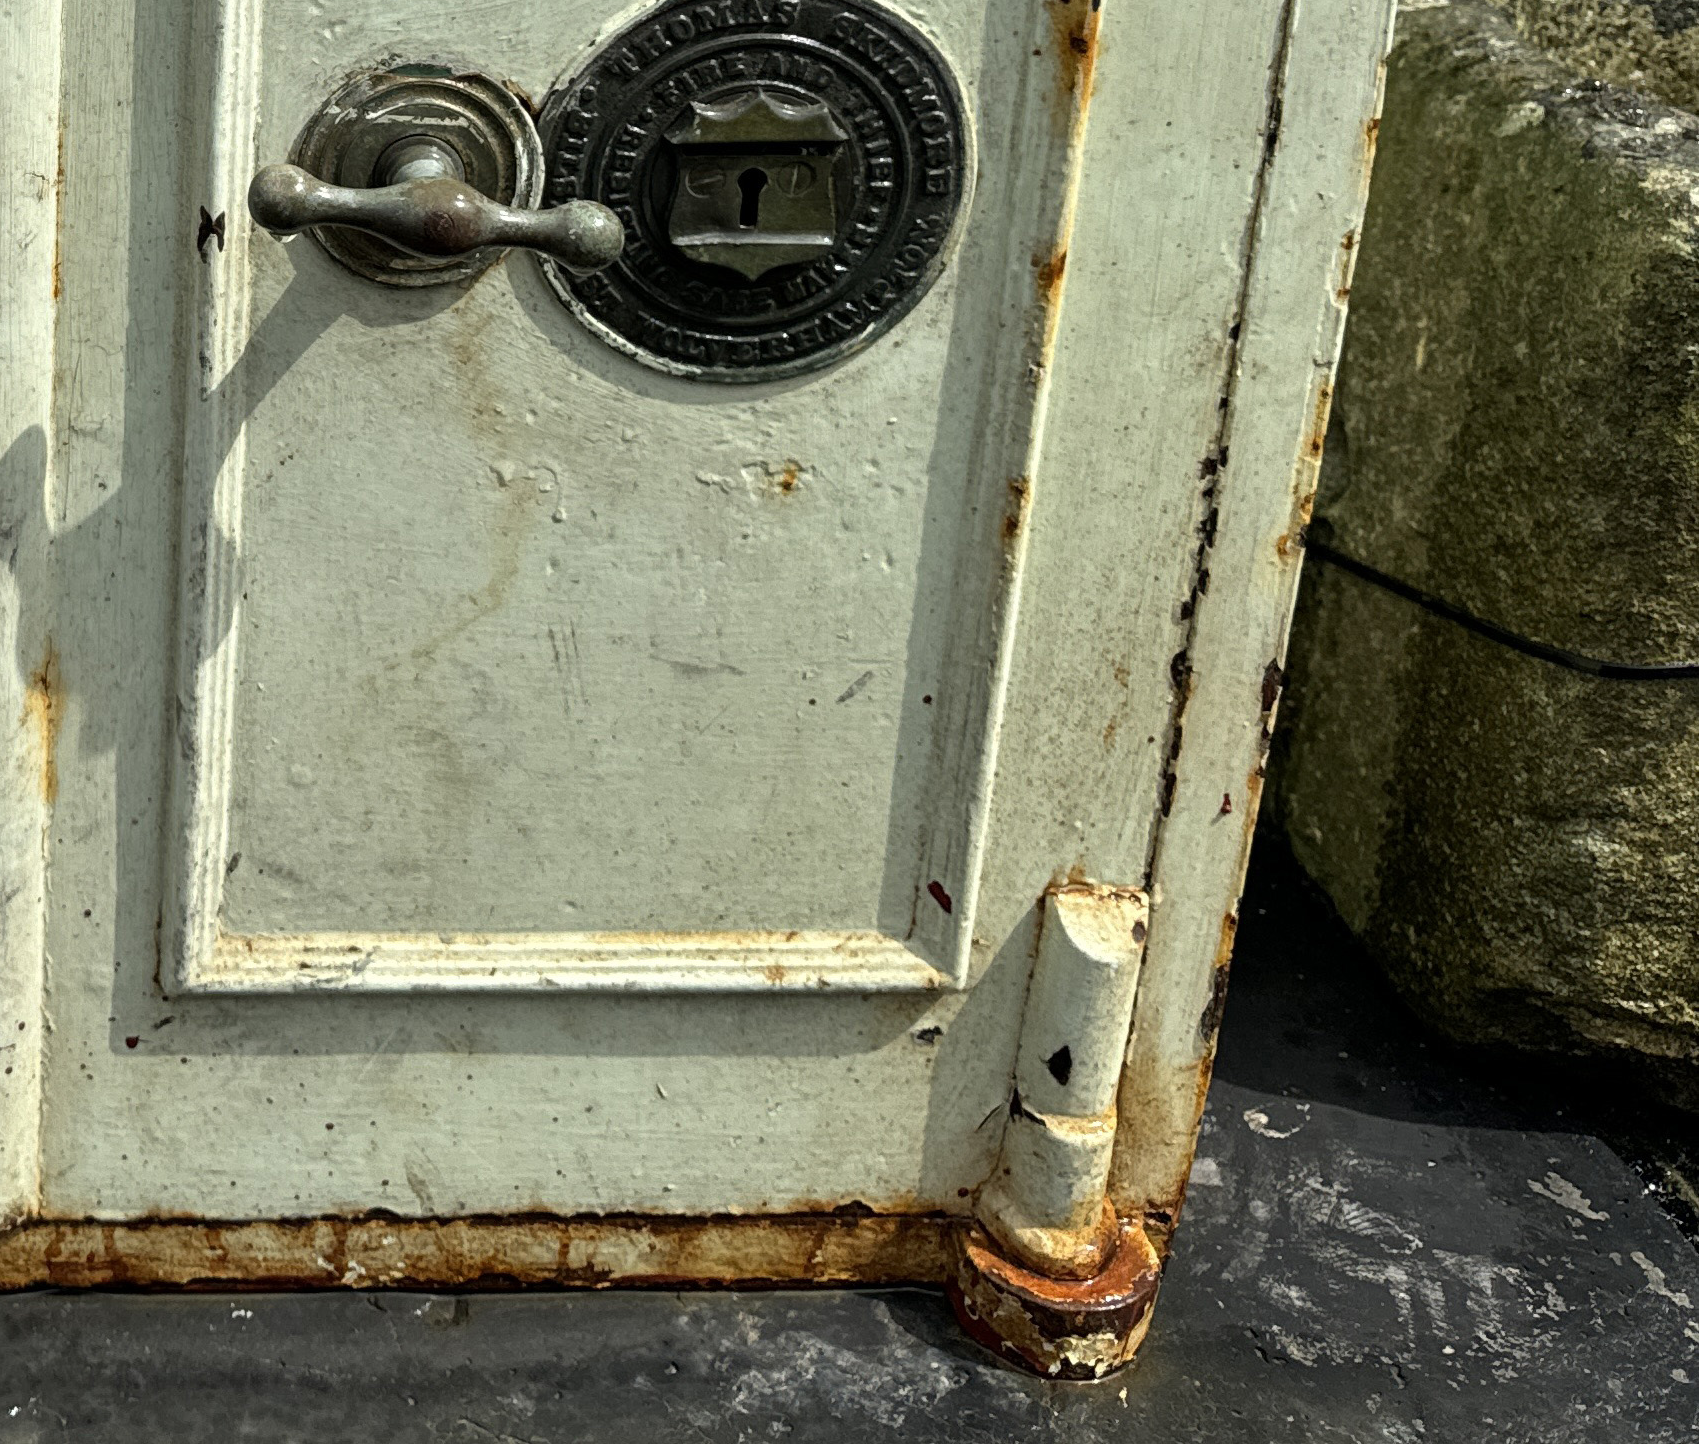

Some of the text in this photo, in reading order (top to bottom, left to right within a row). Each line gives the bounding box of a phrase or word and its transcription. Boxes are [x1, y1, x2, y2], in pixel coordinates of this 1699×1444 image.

[653, 53, 747, 109] FIRE
[762, 51, 835, 88] AND
[831, 13, 952, 197] SKIDMORE
